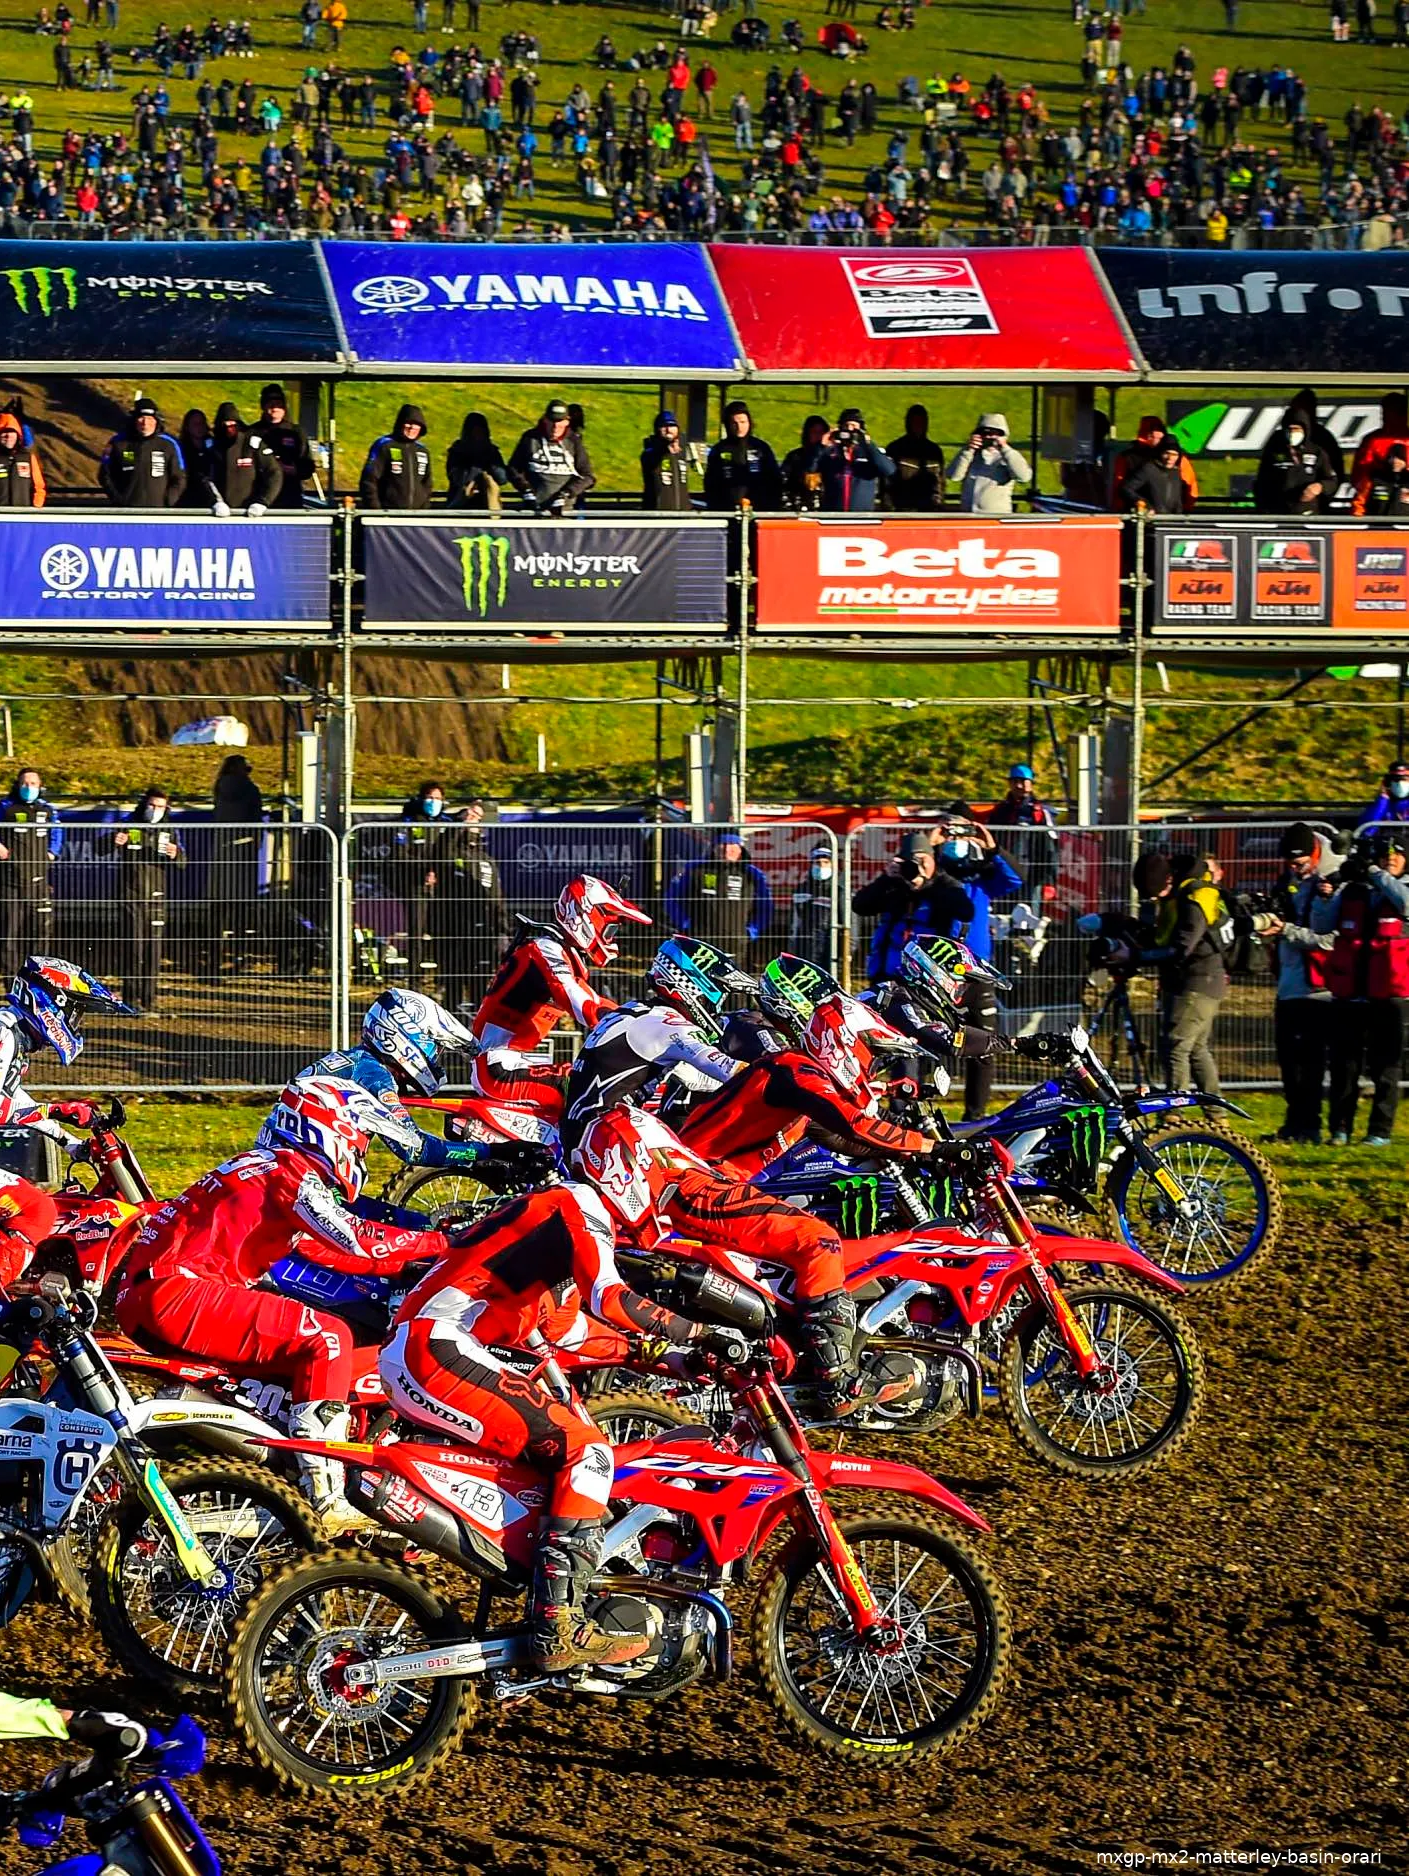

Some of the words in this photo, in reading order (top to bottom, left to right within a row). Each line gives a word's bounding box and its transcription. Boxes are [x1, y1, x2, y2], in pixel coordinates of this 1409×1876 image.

[87, 274, 273, 295] MONSTER
[429, 275, 706, 314] YAMAHA
[359, 303, 542, 316] FACTORY
[563, 305, 710, 321] RACING
[1206, 405, 1384, 450] UO
[89, 547, 255, 589] YAMAHA
[514, 552, 641, 577] MONSTER
[818, 537, 1060, 578] Beta
[533, 578, 623, 589] ENERGY
[1178, 579, 1224, 595] KTM
[1267, 580, 1312, 595] KTM
[1363, 581, 1400, 594] KTM
[42, 589, 155, 601] FACTORY
[164, 590, 255, 602] RACING
[819, 584, 1058, 611] motorcycles
[635, 1299, 676, 1326] FOX
[397, 1371, 478, 1433] HONDA
[439, 1453, 514, 1468] HONDA
[385, 1661, 422, 1674] GOSHI
[426, 1657, 451, 1669] DID
[842, 1737, 915, 1755] PIRELLI
[328, 1755, 415, 1786] PIRELLI
